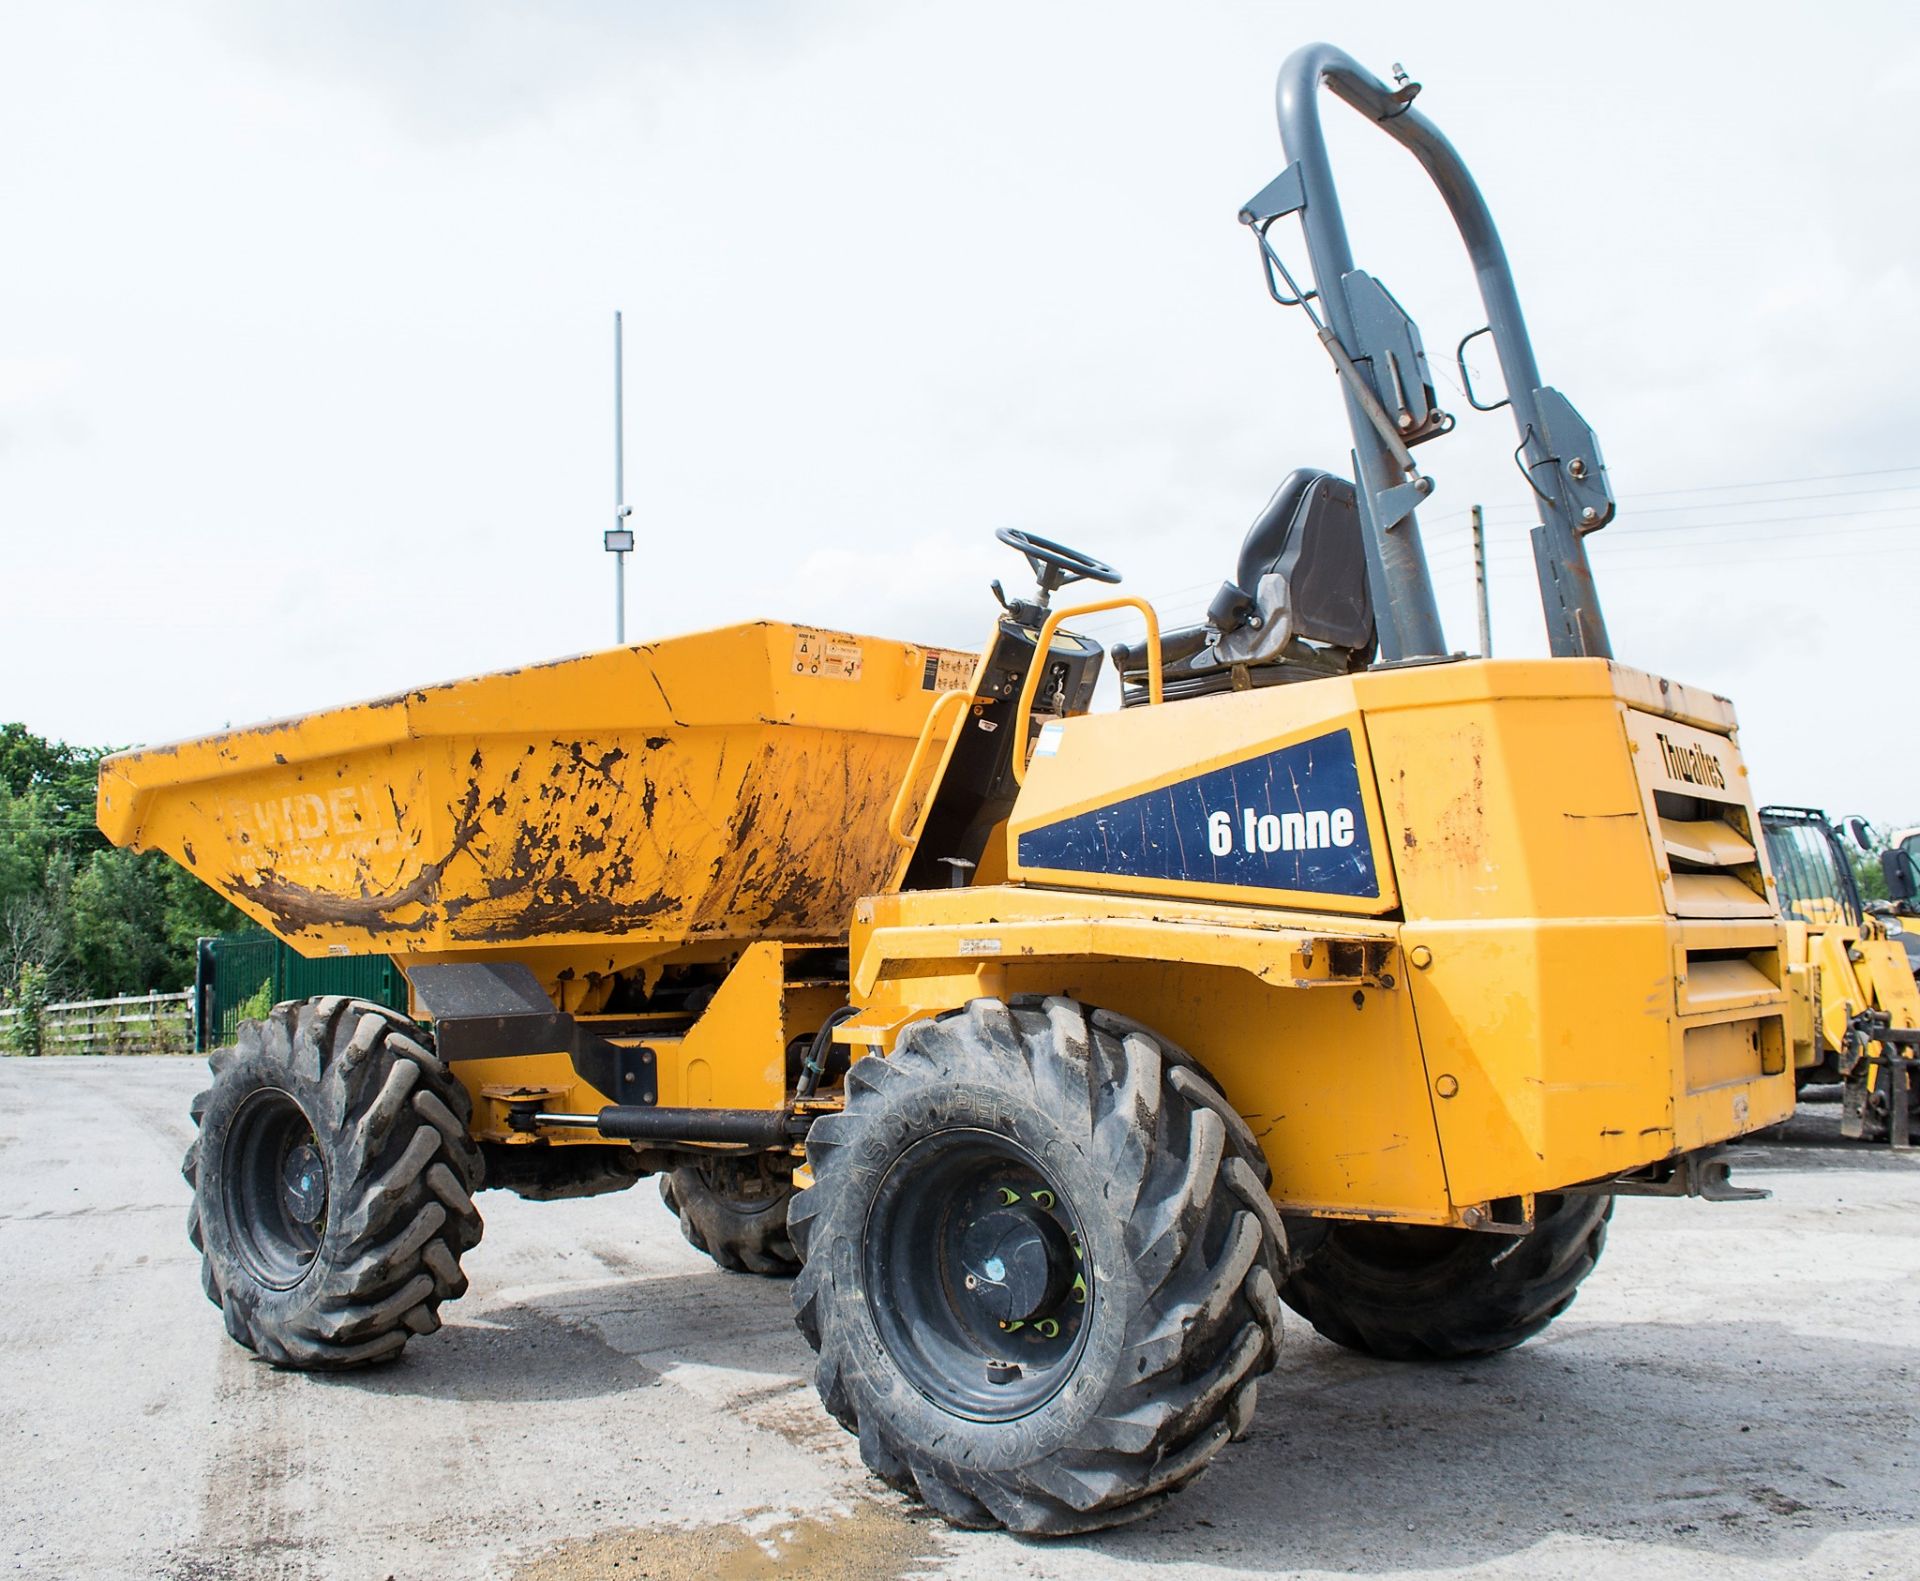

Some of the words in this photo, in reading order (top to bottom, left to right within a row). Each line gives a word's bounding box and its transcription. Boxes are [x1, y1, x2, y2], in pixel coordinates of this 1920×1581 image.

[1656, 733, 1725, 790] Thwaites
[1208, 811, 1233, 856] 6
[1243, 807, 1355, 853] tonne
